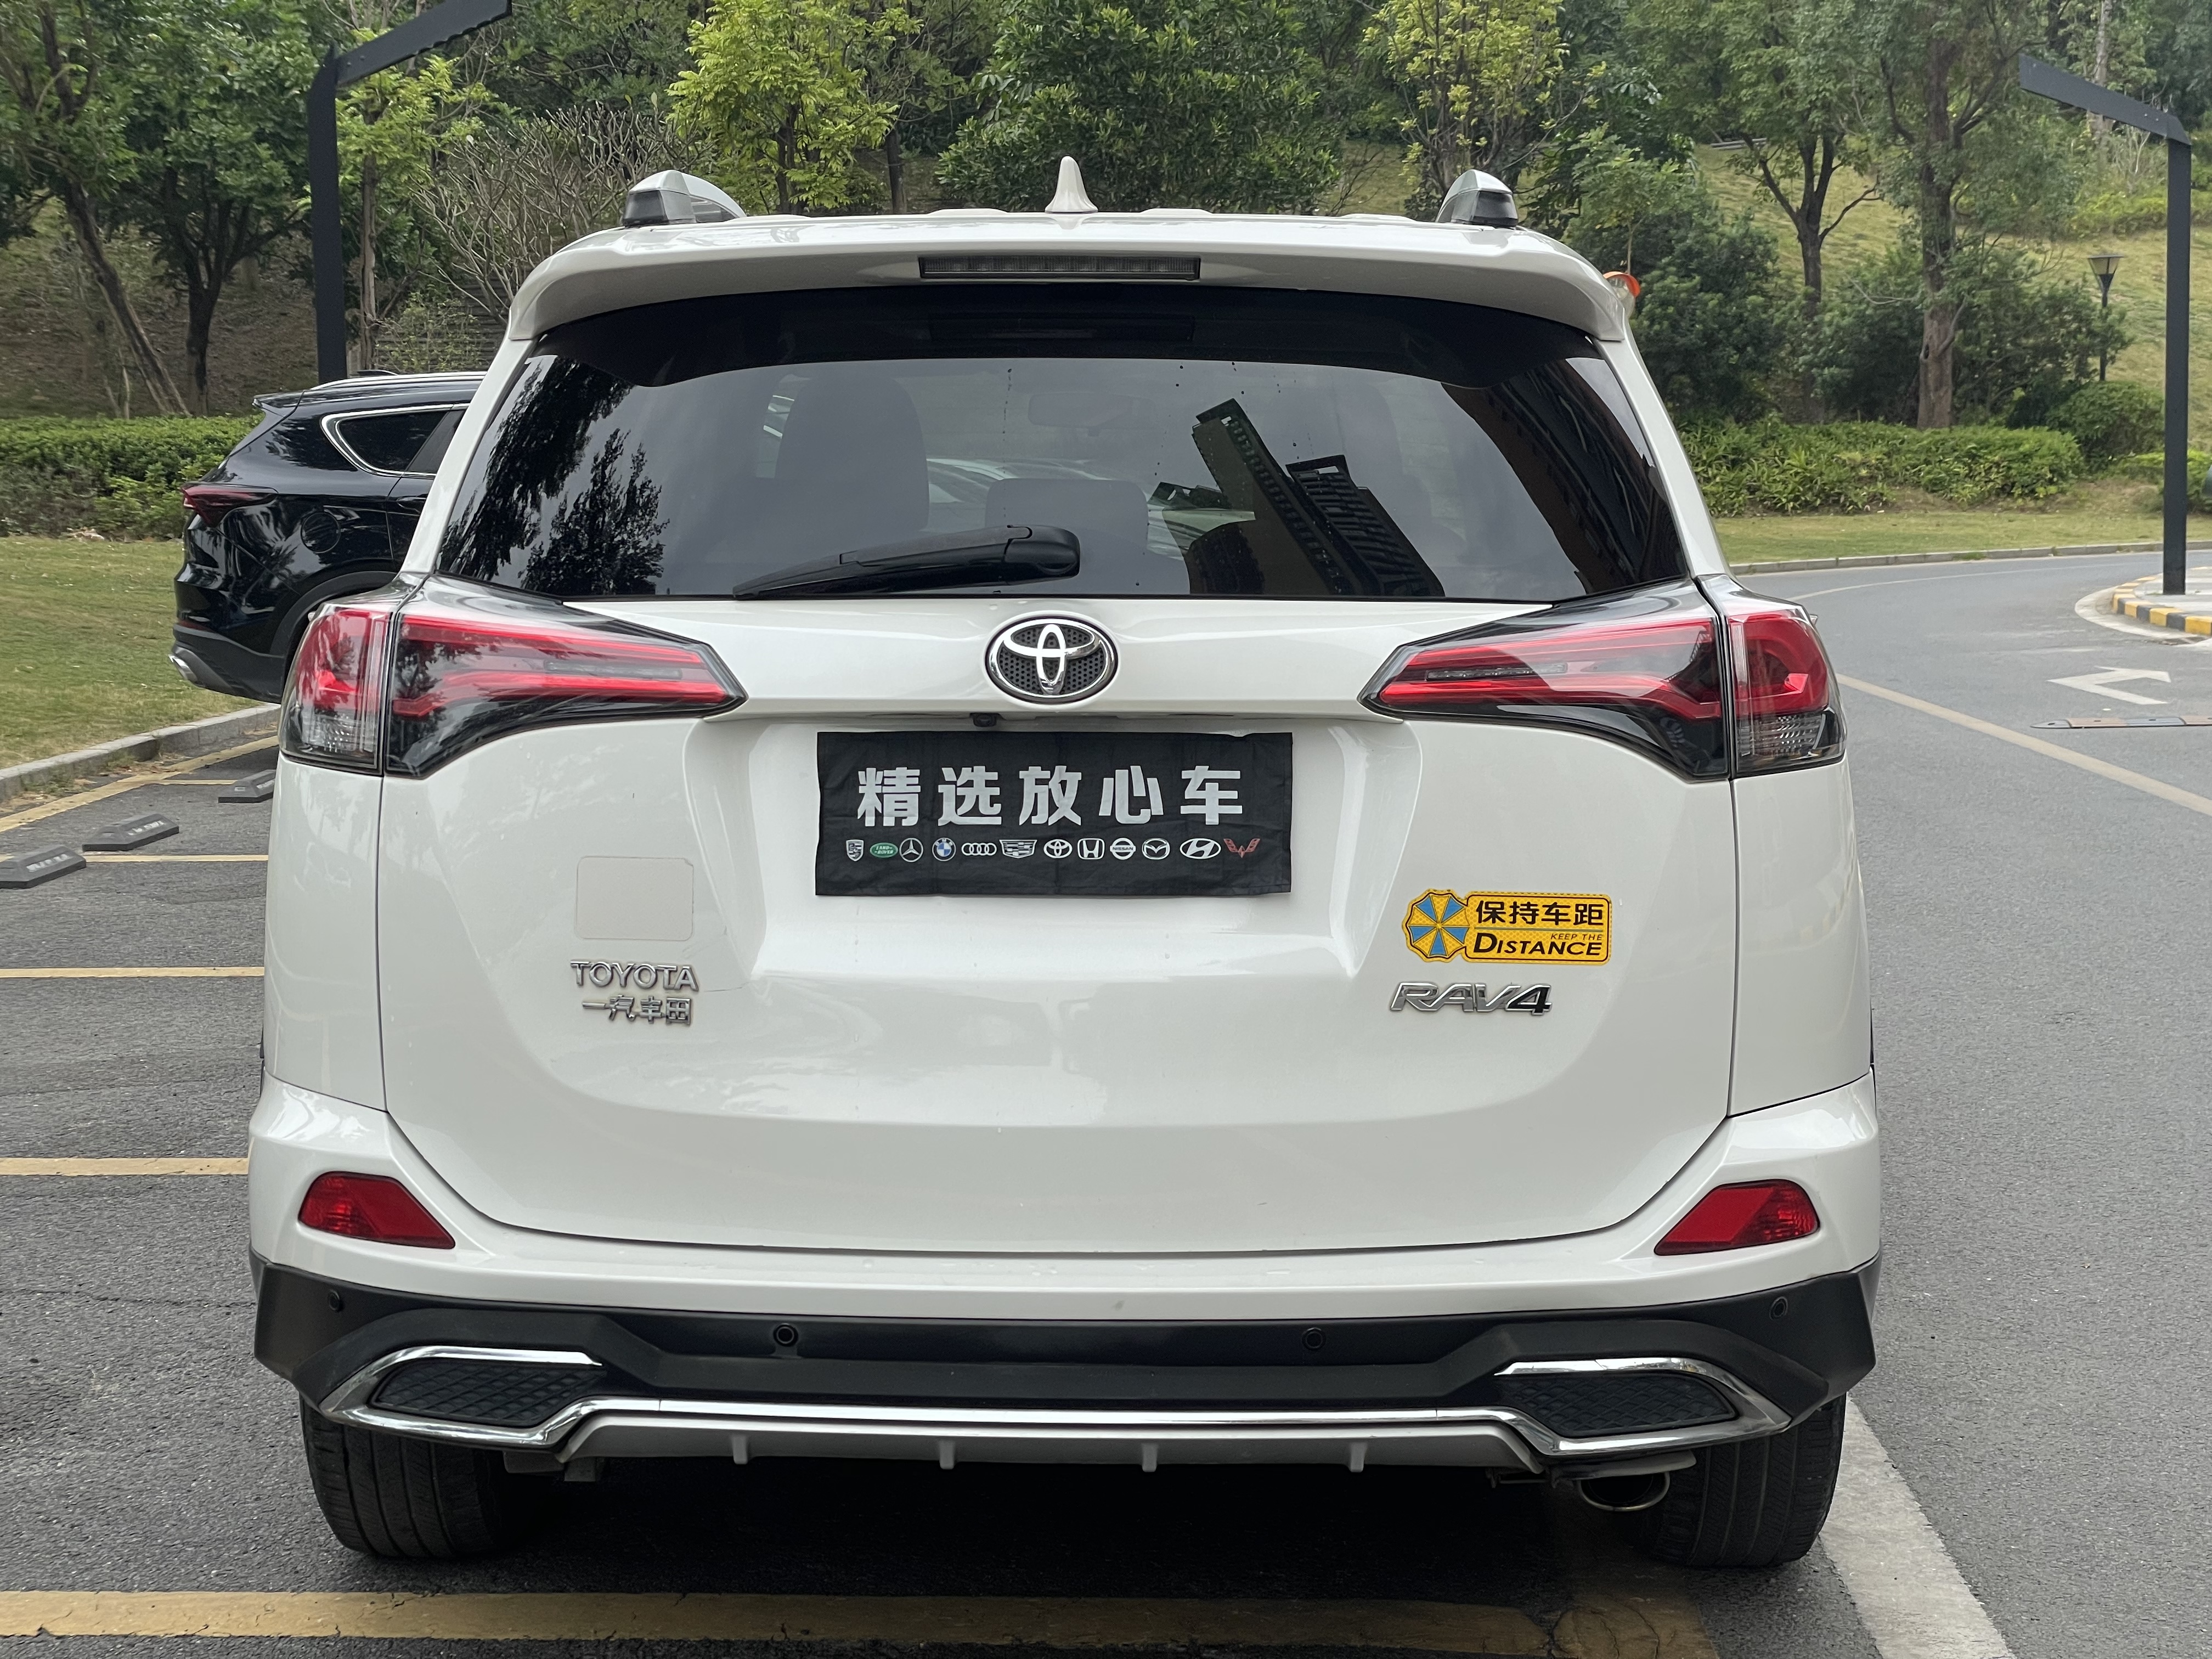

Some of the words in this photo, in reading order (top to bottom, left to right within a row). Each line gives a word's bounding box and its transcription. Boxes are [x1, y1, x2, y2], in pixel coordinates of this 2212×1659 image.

[857, 765, 1243, 827] 精选放心车
[1476, 900, 1604, 926] 保持车距
[1473, 932, 1602, 956] DISTANCE
[570, 961, 699, 992] TOYOTA
[582, 994, 692, 1025] 一汽丰田
[1389, 981, 1554, 1016] RAV4
